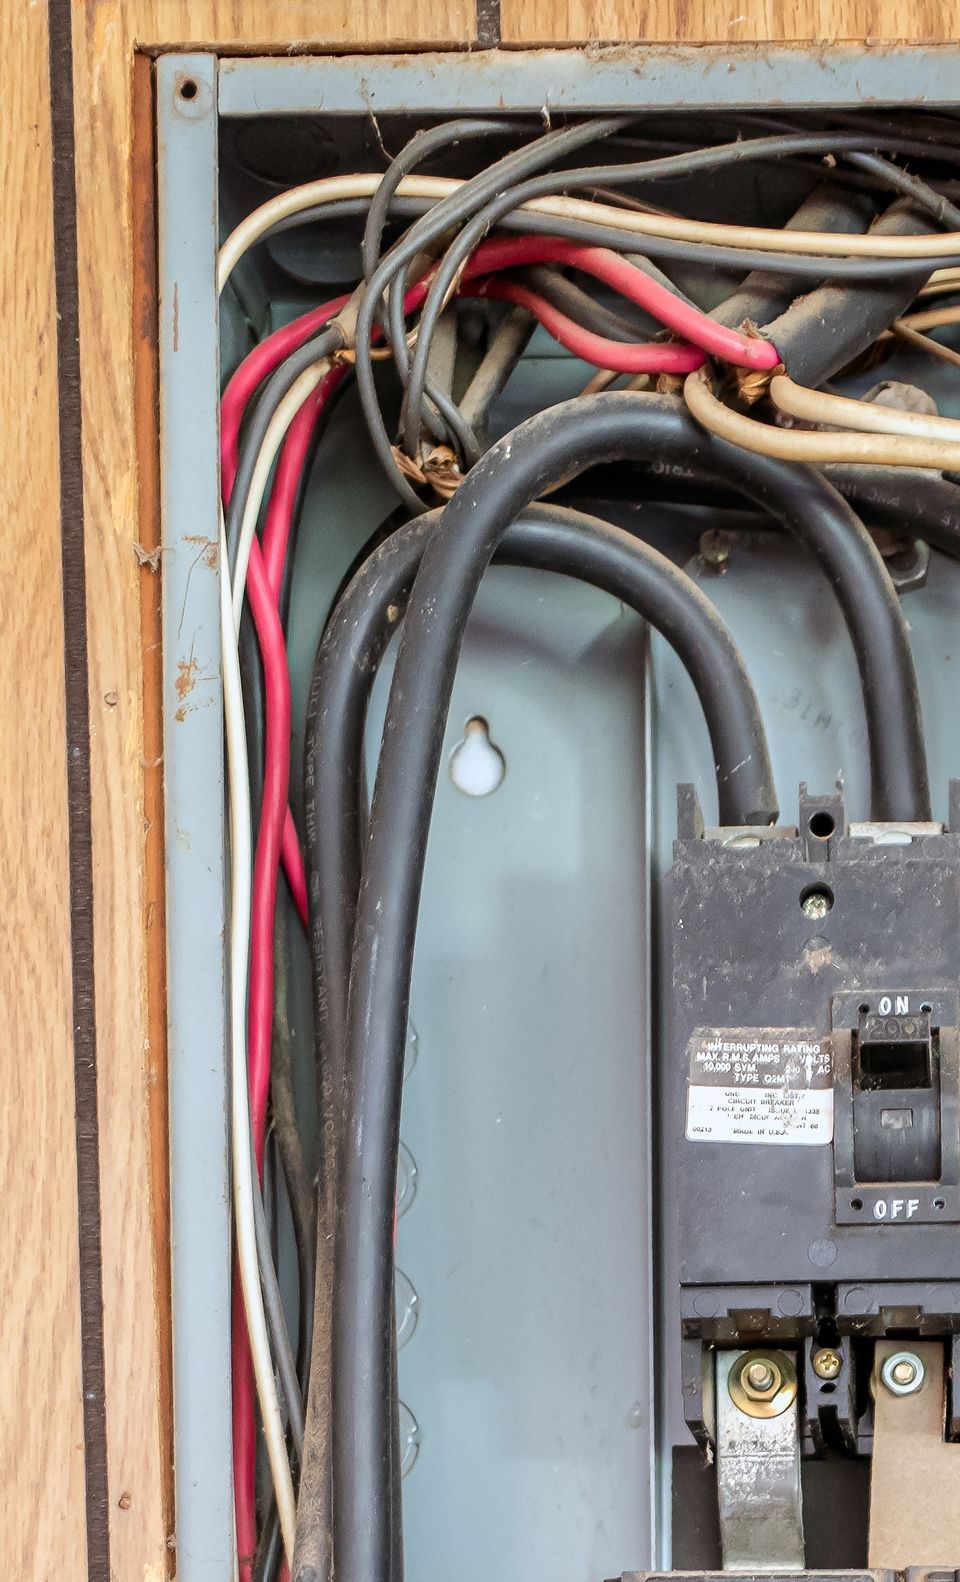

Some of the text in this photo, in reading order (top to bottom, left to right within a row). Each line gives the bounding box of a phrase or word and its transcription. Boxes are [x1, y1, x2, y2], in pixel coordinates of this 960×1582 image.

[878, 996, 909, 1016] ON
[707, 1042, 820, 1054] INTERRUPTING RATING
[751, 1054, 780, 1064] AMPS
[816, 1065, 831, 1075] AC
[734, 1073, 759, 1083] TYPE
[873, 1199, 920, 1220] OFF
